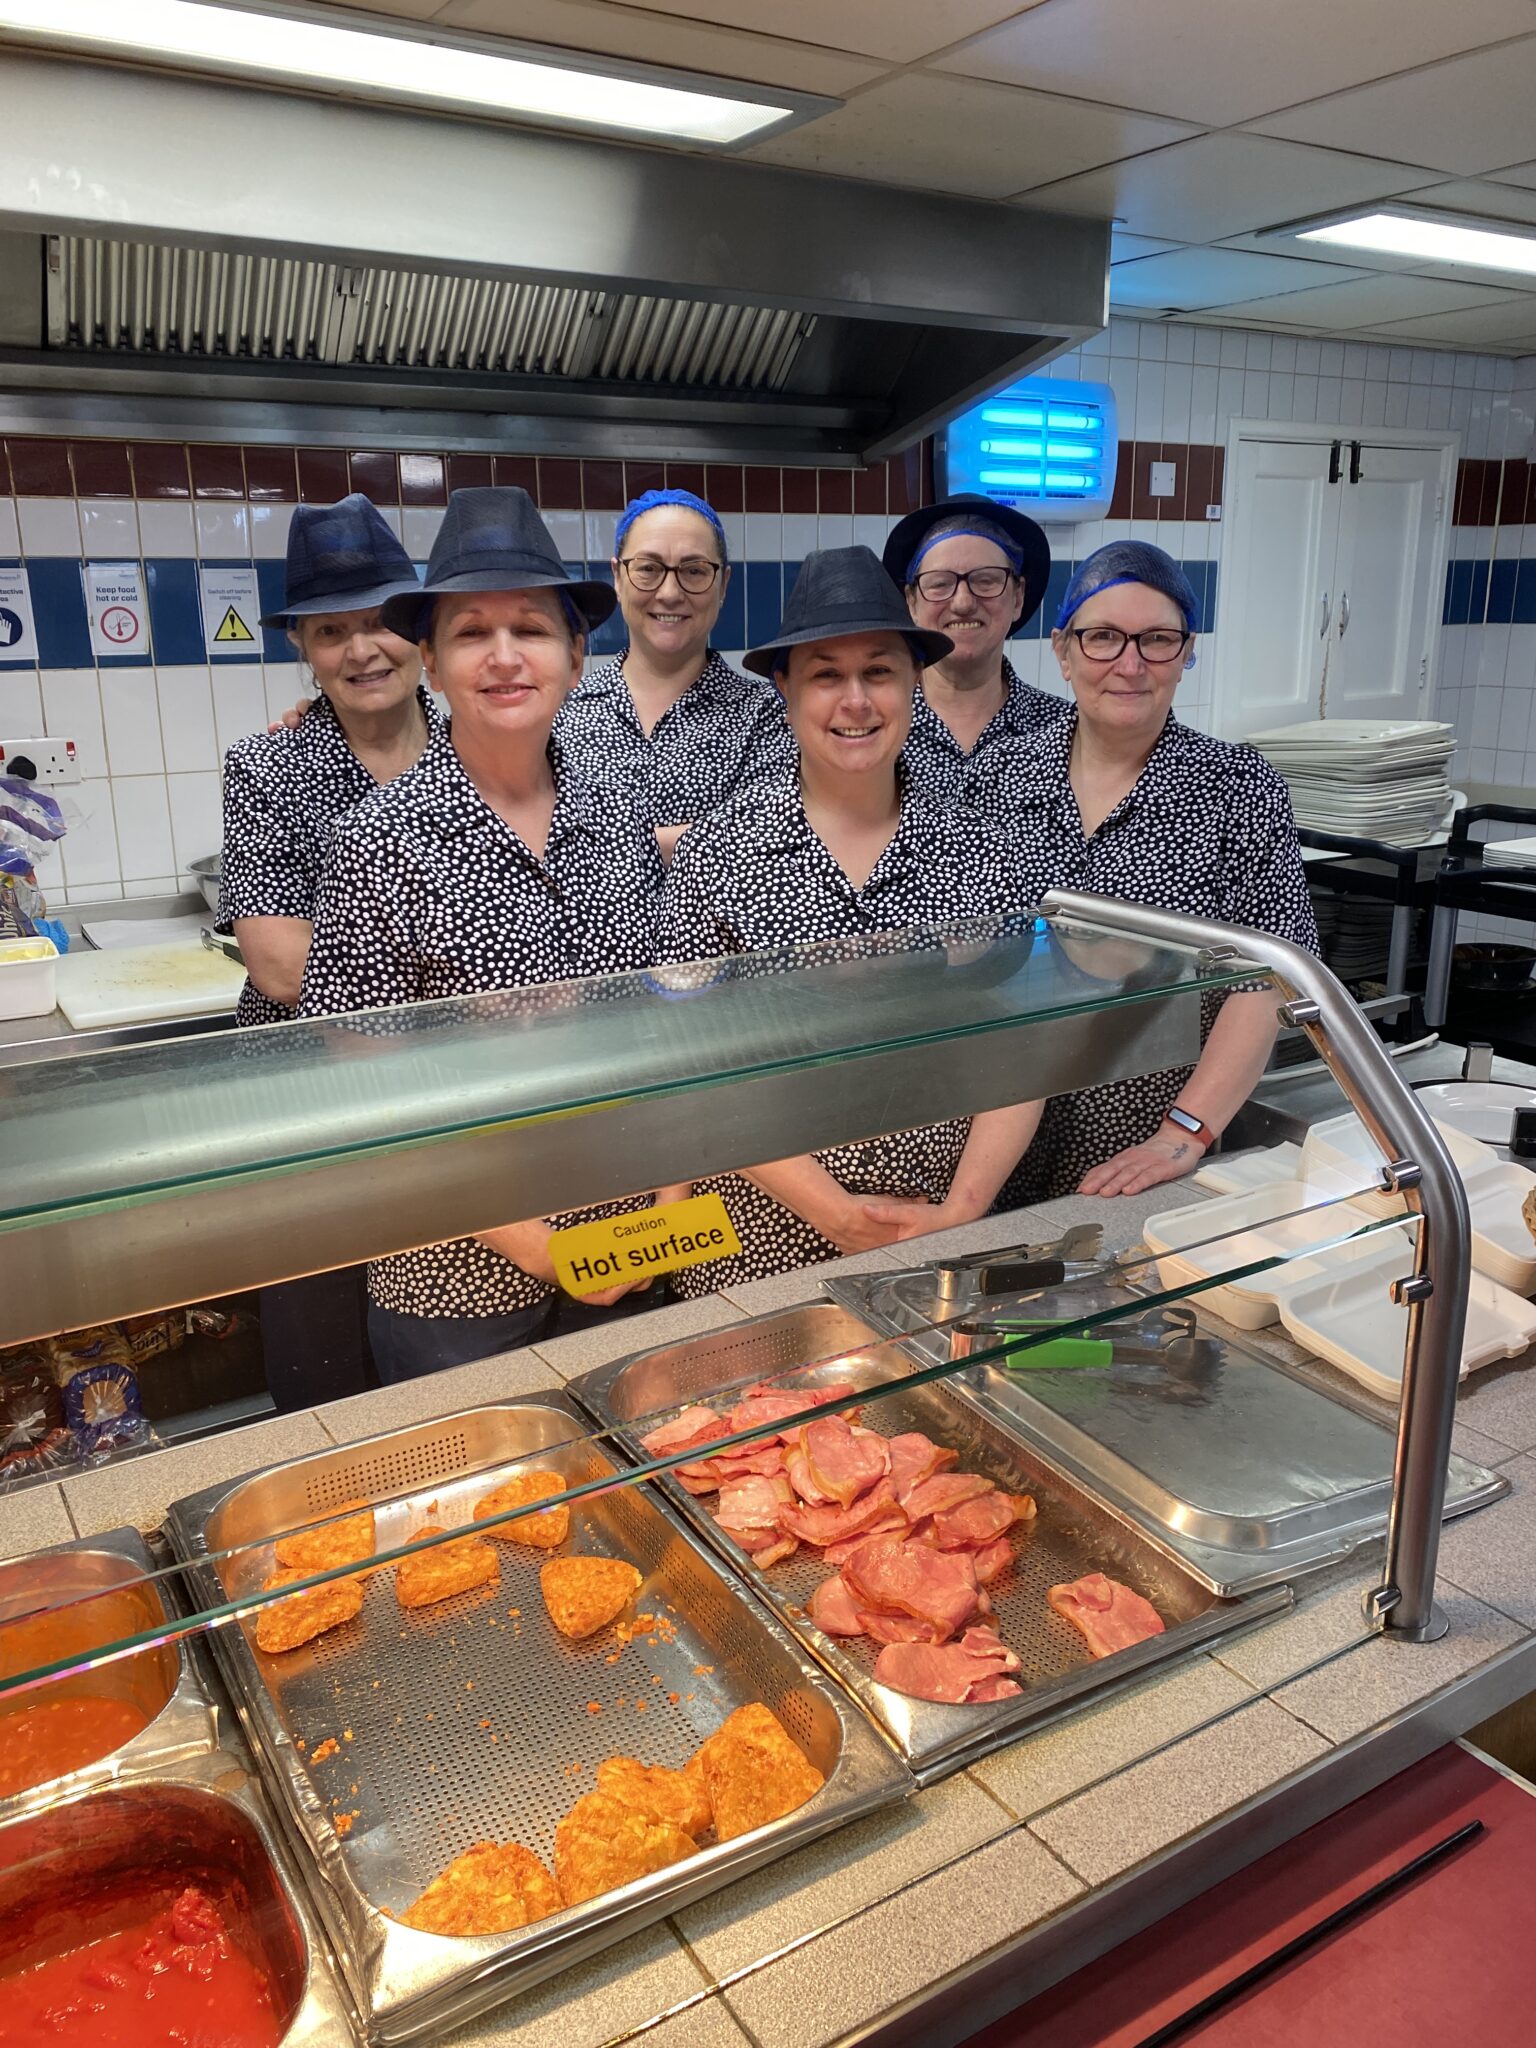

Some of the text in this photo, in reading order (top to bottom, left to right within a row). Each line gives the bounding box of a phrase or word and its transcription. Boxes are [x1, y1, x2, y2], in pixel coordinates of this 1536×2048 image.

[96, 586, 117, 594] Keep
[612, 1217, 667, 1238] Caution
[569, 1227, 726, 1283] Hot surface
